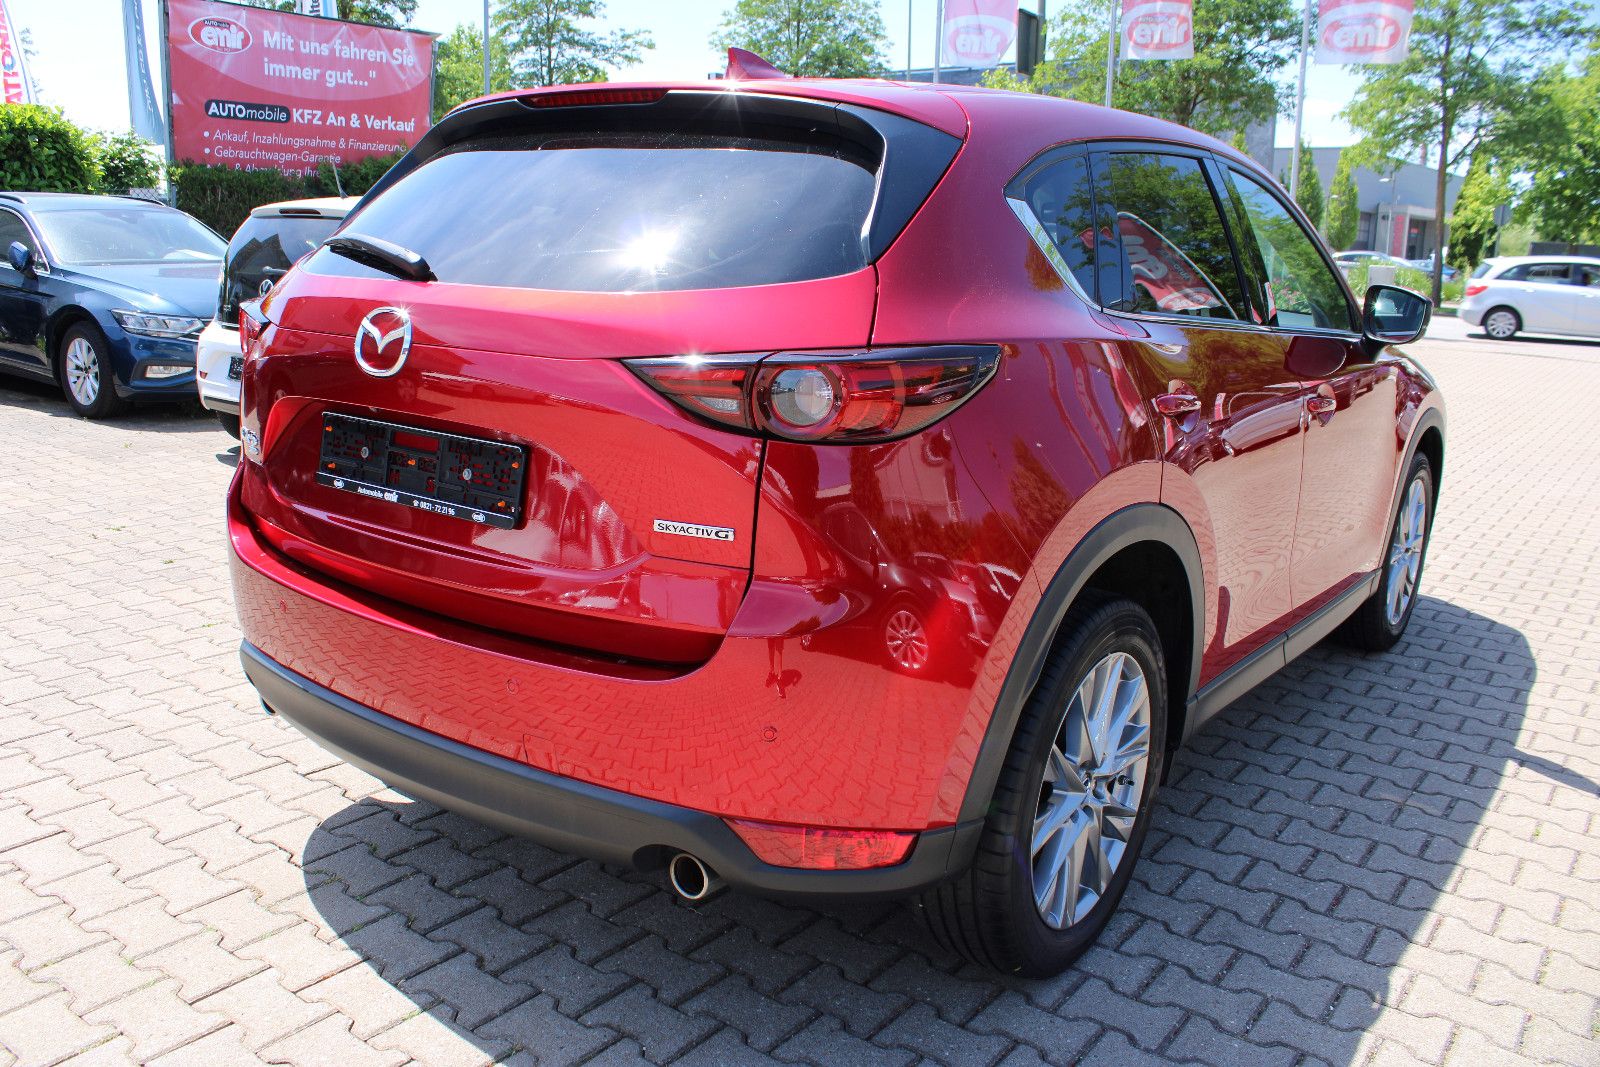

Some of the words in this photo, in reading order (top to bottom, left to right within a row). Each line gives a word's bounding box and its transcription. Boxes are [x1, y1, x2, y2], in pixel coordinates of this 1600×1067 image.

[201, 25, 244, 50] emir
[1134, 16, 1188, 44] emir
[1333, 18, 1395, 48] emir
[263, 30, 294, 51] Mit
[299, 39, 329, 56] uns
[334, 39, 387, 63] fahren
[392, 47, 414, 67] Sie
[263, 57, 320, 80] immer
[208, 101, 287, 121] AUTOmobile
[292, 108, 322, 125] KFZ
[326, 111, 345, 127] An
[350, 113, 360, 128] &
[364, 114, 415, 132] Verkauf
[213, 129, 249, 144] Ankauf,
[252, 132, 336, 149] Inzahlungsnahme
[338, 137, 346, 149] &
[214, 146, 341, 163] Gebrauchtwagen-Garantie
